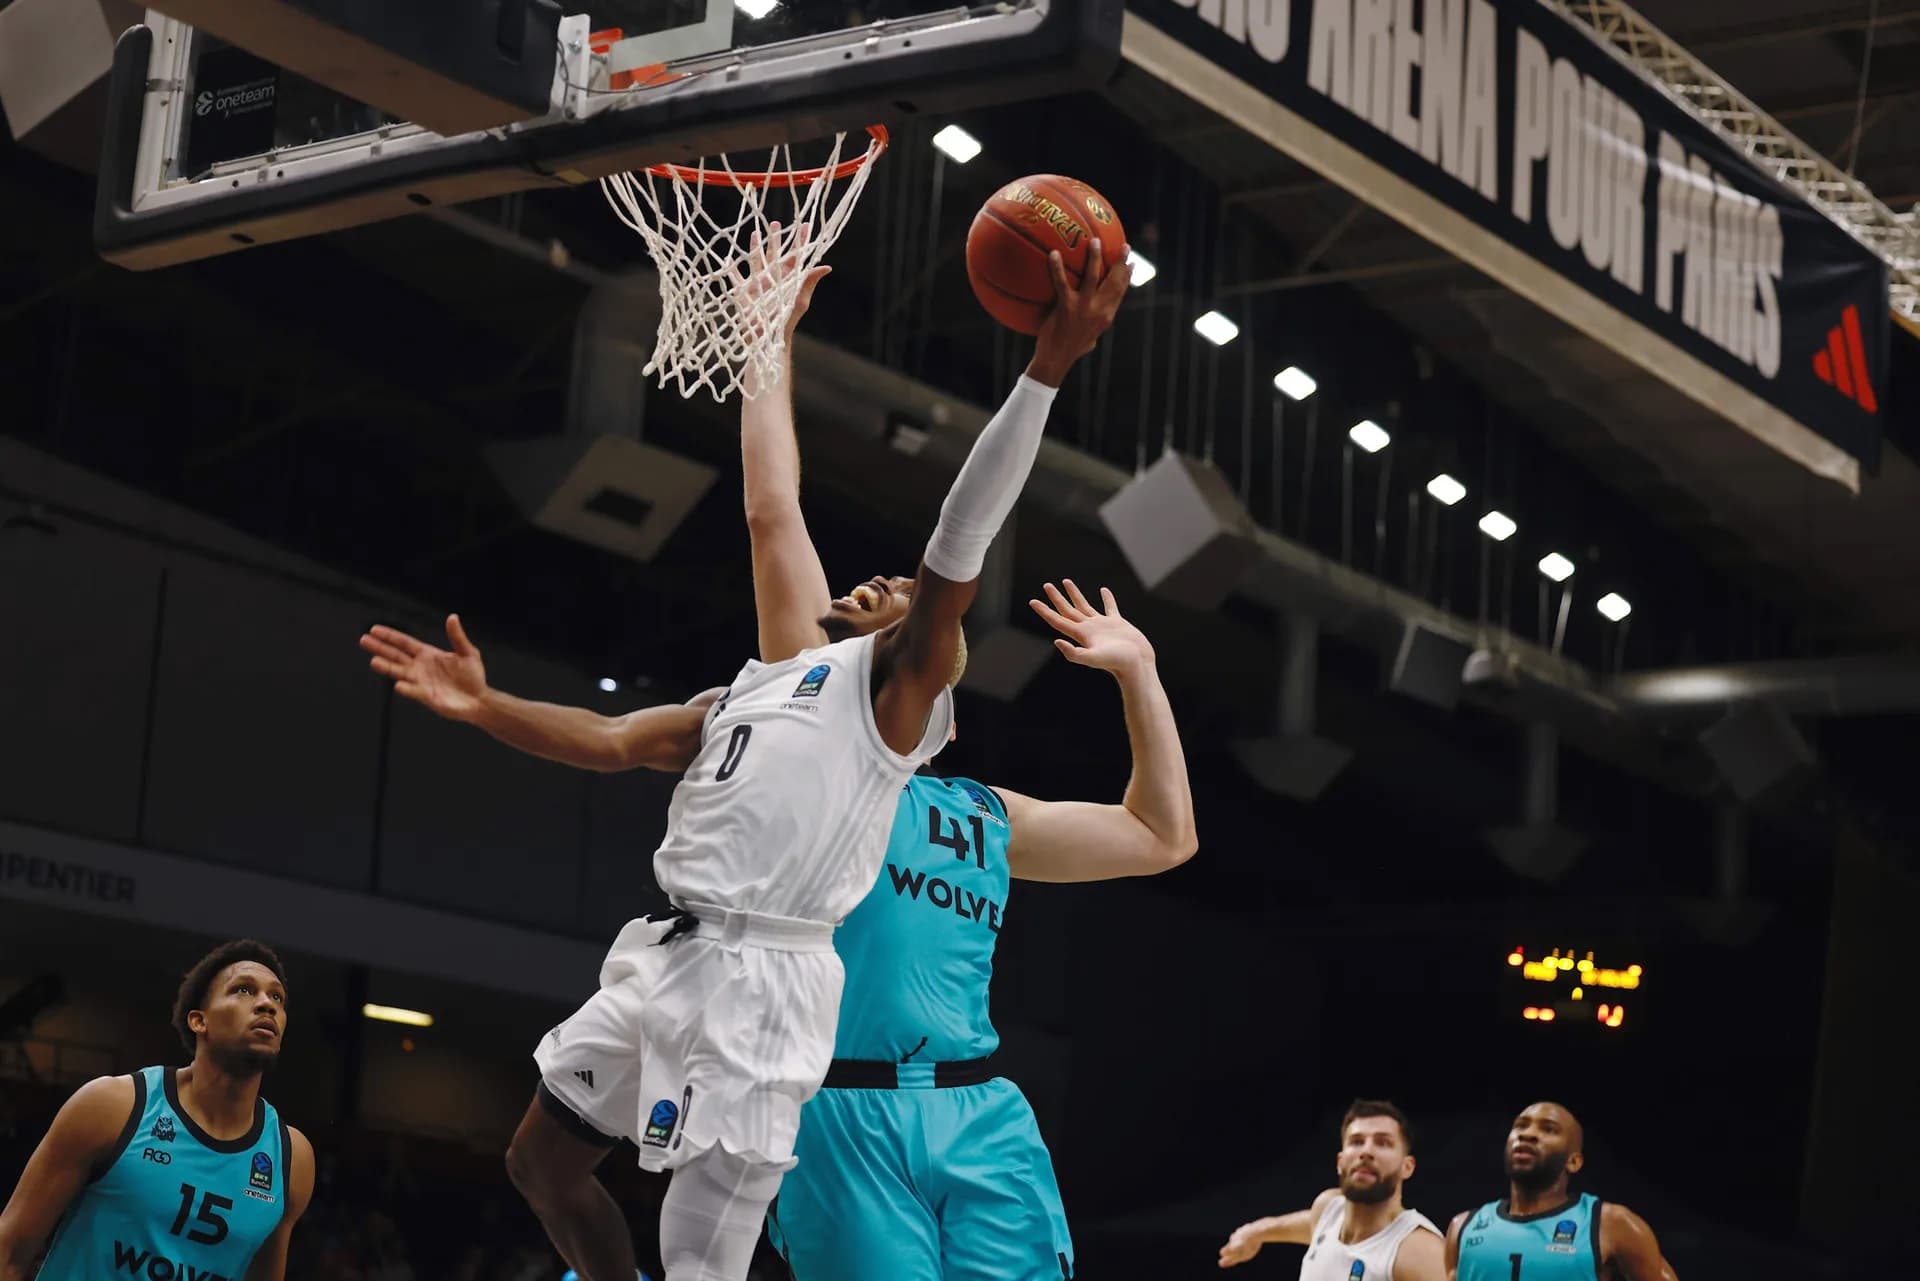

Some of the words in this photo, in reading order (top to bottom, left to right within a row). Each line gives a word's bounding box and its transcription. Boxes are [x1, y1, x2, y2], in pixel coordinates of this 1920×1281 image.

[216, 85, 276, 111] oneteam
[999, 183, 1091, 249] SPALDIN
[1512, 26, 1648, 296] POUR
[1655, 129, 1784, 380] PARIS
[715, 724, 752, 782] 0
[928, 805, 986, 871] 41
[0, 852, 137, 904] PENTIER
[170, 1182, 234, 1246] 15
